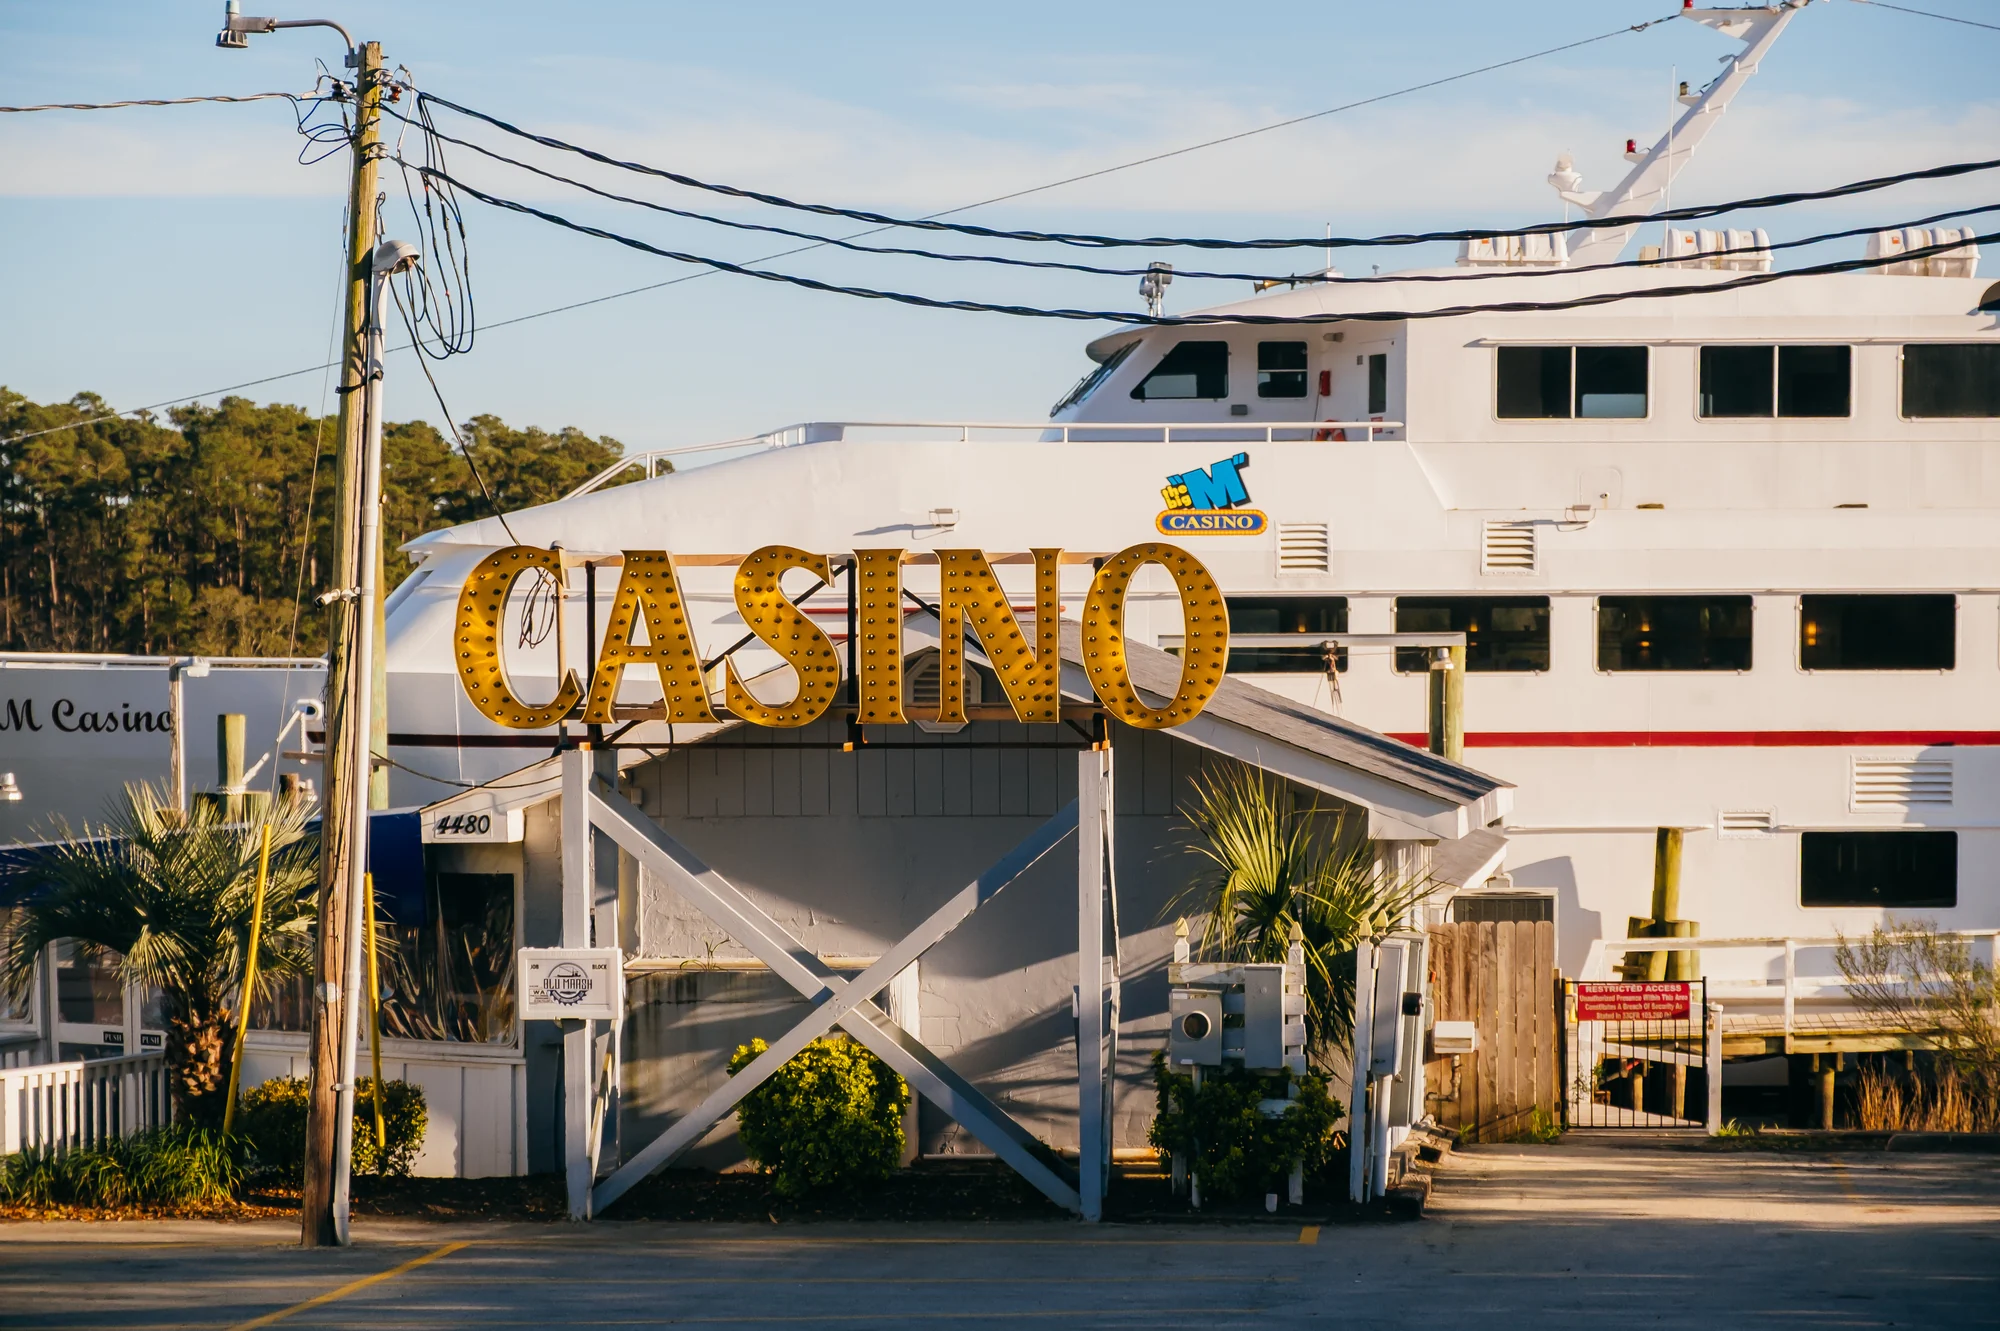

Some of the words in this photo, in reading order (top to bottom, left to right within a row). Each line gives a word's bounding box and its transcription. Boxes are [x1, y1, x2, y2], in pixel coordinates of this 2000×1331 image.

[1161, 484, 1188, 502] the
[1165, 494, 1193, 510] big
[1169, 515, 1254, 529] CASINO
[453, 541, 1231, 730] CASINO
[0, 698, 43, 732] M
[436, 814, 491, 835] 4480
[543, 978, 561, 990] BLU
[562, 978, 593, 990] MARSH
[1585, 984, 1643, 993] RESTRICTED
[1645, 984, 1682, 992] ACCESS
[1579, 994, 1616, 1002] Unauthorized
[1616, 994, 1642, 1002] Presence
[1651, 1003, 1675, 1012] Security
[104, 1032, 122, 1042] PUSH
[141, 1035, 160, 1045] PUSH
